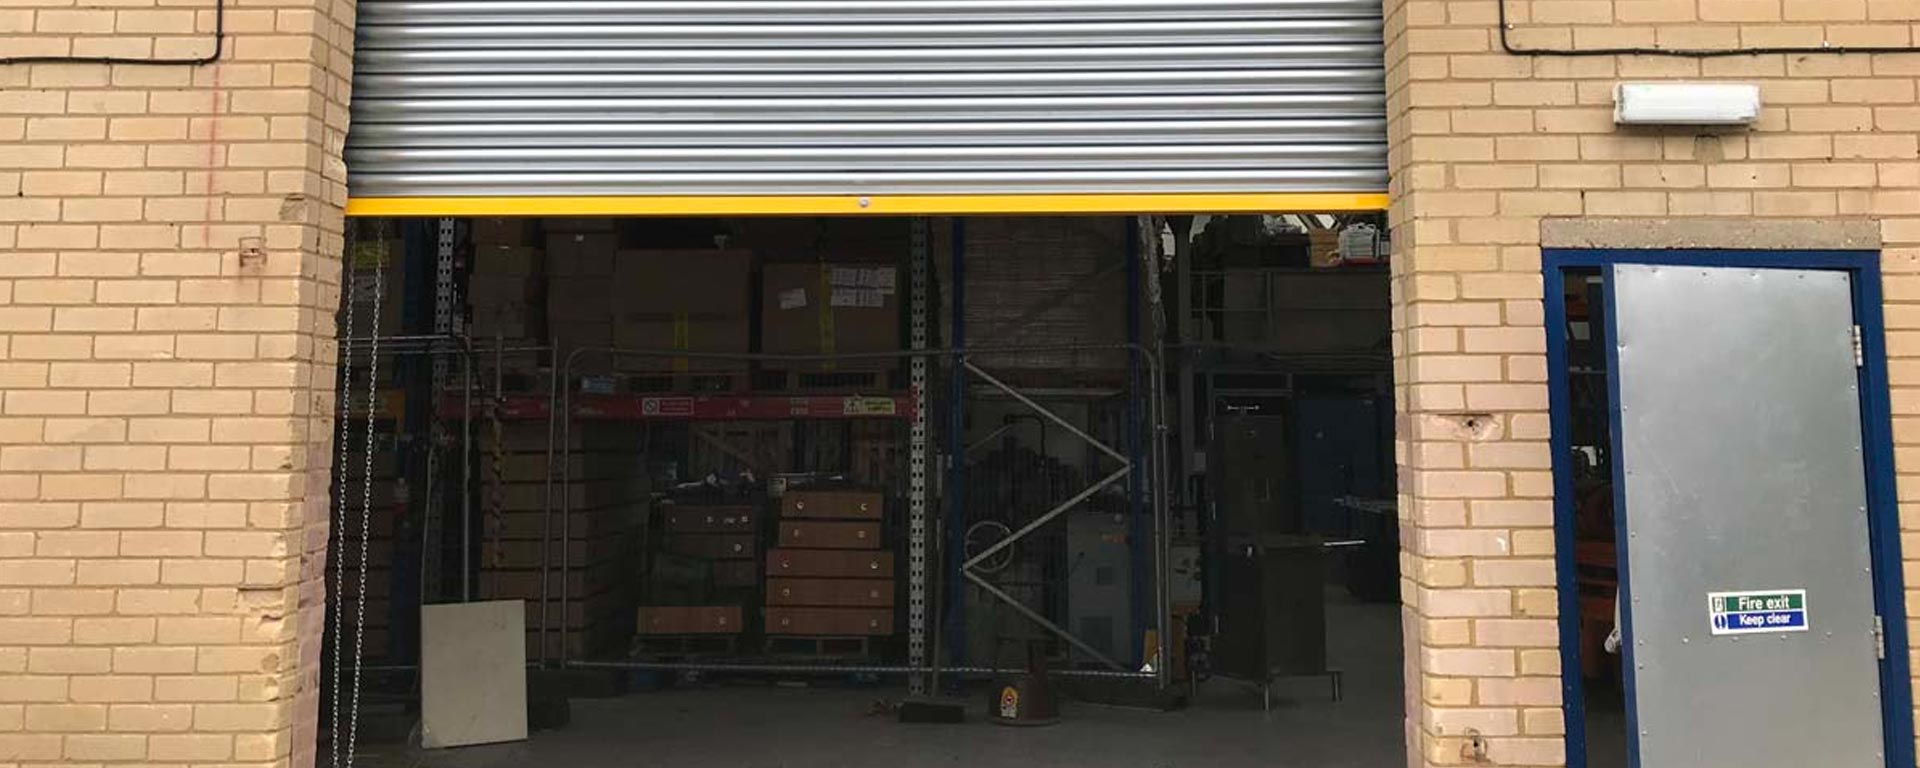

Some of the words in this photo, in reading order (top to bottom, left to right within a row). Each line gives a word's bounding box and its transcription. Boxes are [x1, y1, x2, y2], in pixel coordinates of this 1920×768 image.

[1738, 596, 1763, 610] Fire
[1766, 594, 1790, 610] exit
[1739, 613, 1765, 627] Keep
[1766, 612, 1791, 625] clear
